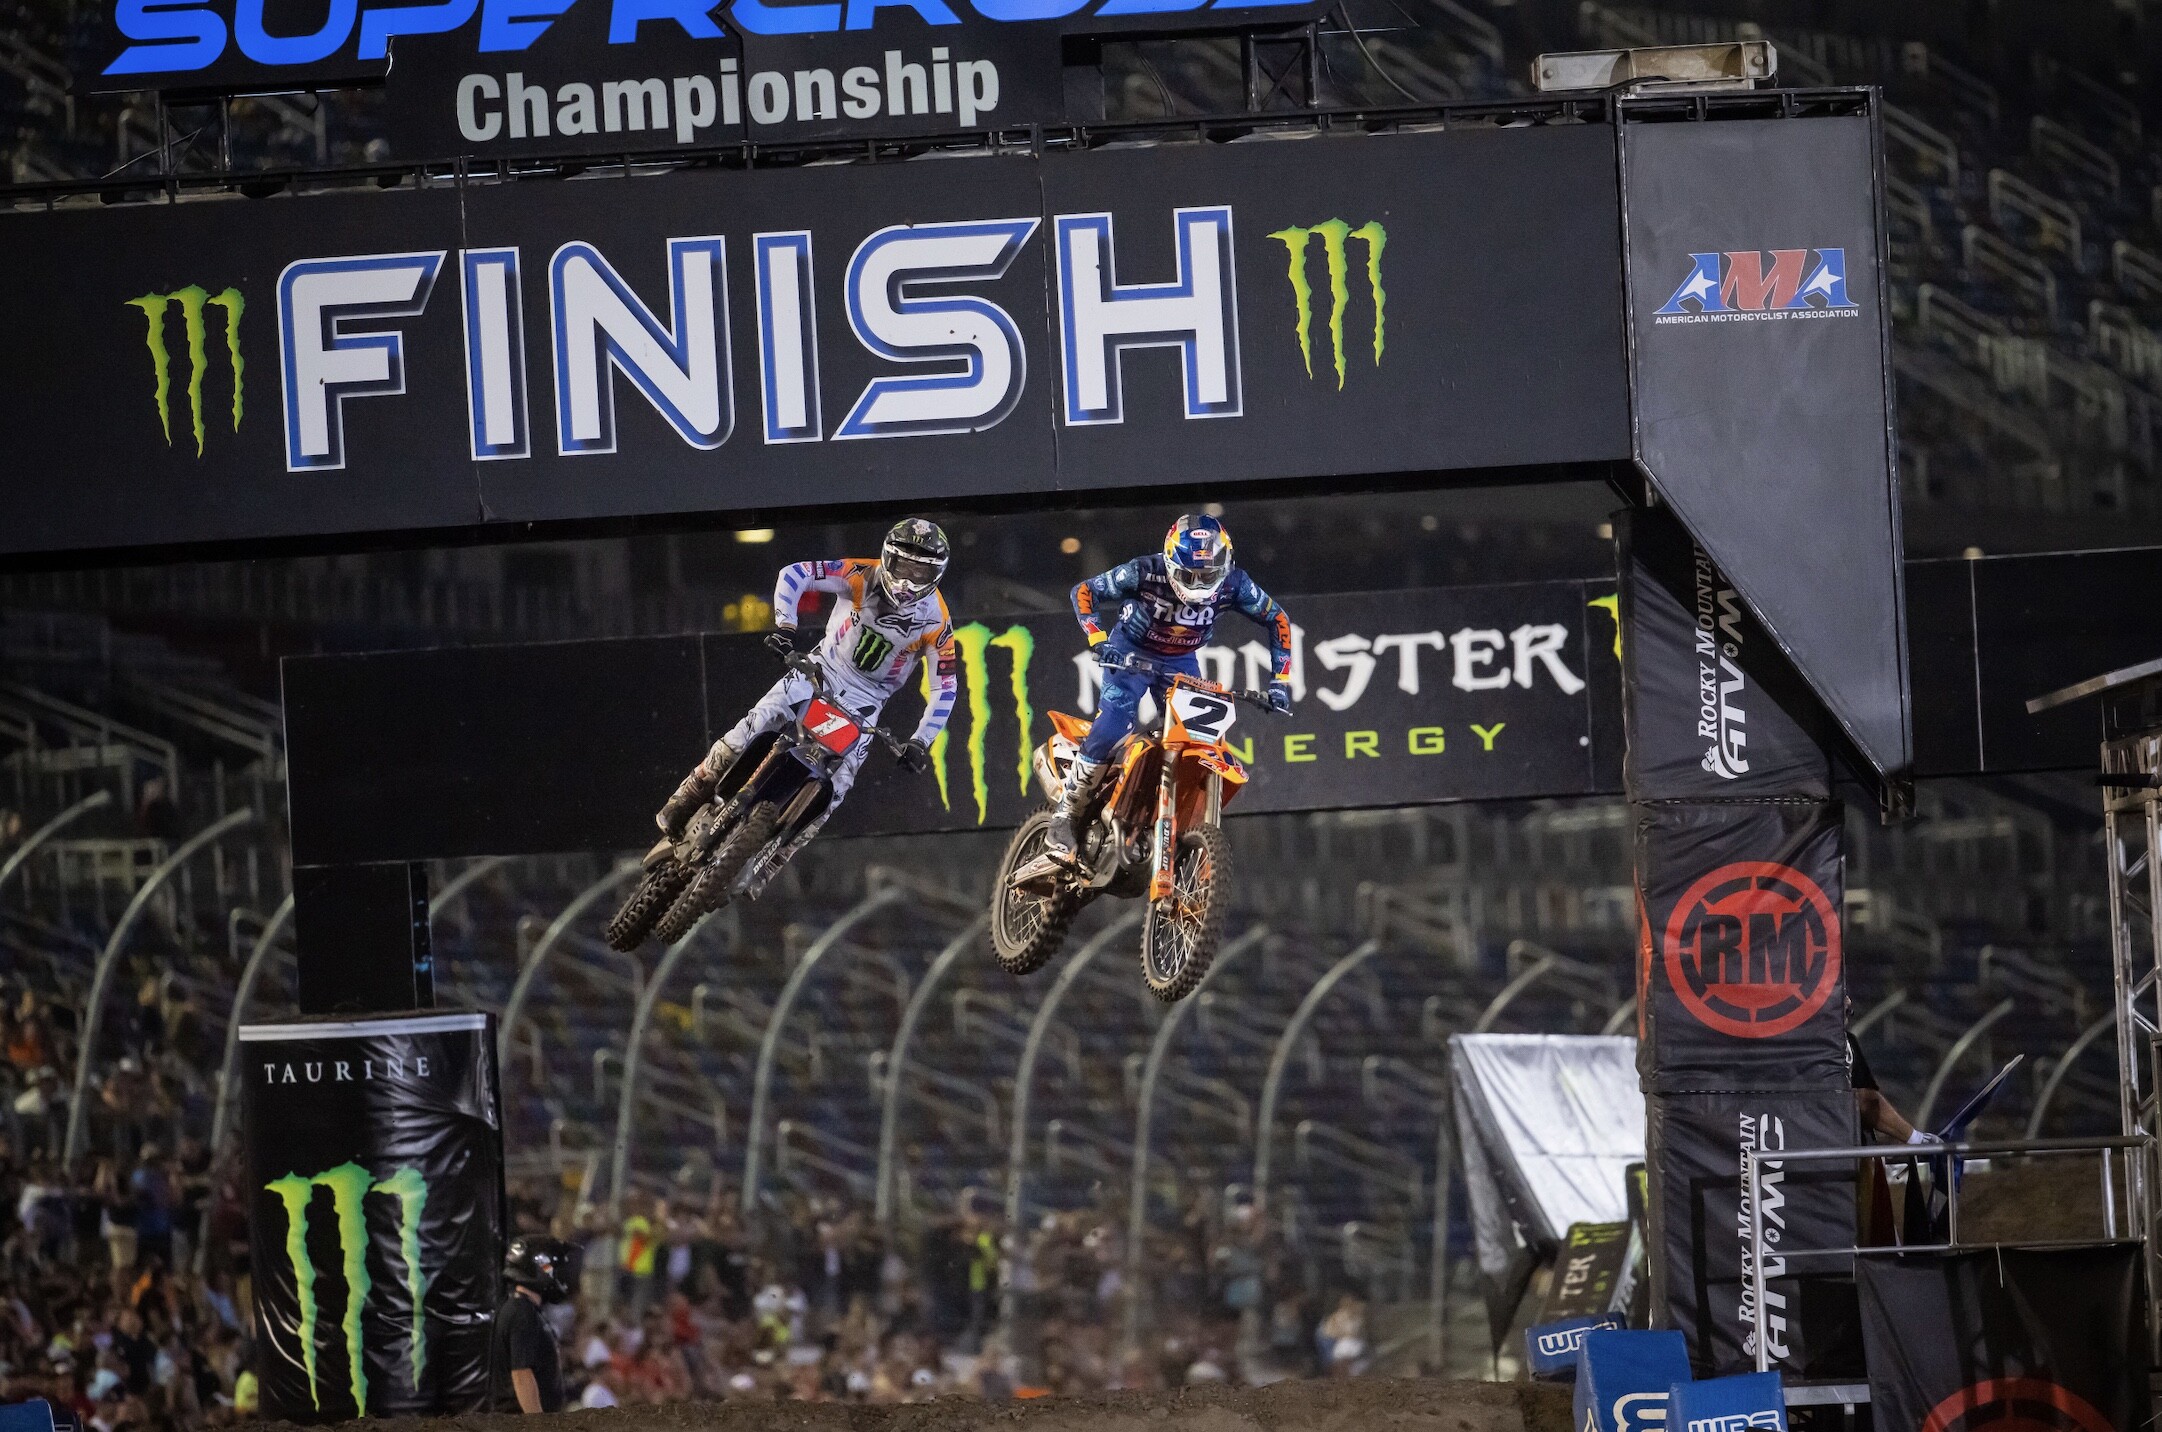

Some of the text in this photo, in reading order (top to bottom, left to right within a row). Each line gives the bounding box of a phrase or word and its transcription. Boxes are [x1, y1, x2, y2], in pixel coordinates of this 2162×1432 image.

[100, 0, 1317, 75] SUPER
[456, 47, 1000, 144] Championship
[1653, 247, 1860, 314] AMA
[276, 205, 1244, 473] FINISH
[1655, 309, 1860, 325] AMERICAN MOTORCYCLIST ASSOCIATION
[1694, 540, 1718, 741] ROCKY MOUNTAI
[811, 711, 851, 738] 1
[1182, 696, 1229, 738] 2
[1222, 722, 1507, 766] NERGY
[752, 835, 783, 876] DUNLOP
[1701, 913, 1807, 985] RM
[263, 1056, 430, 1085] TAURINE
[1738, 1245, 1756, 1323] ROCKY
